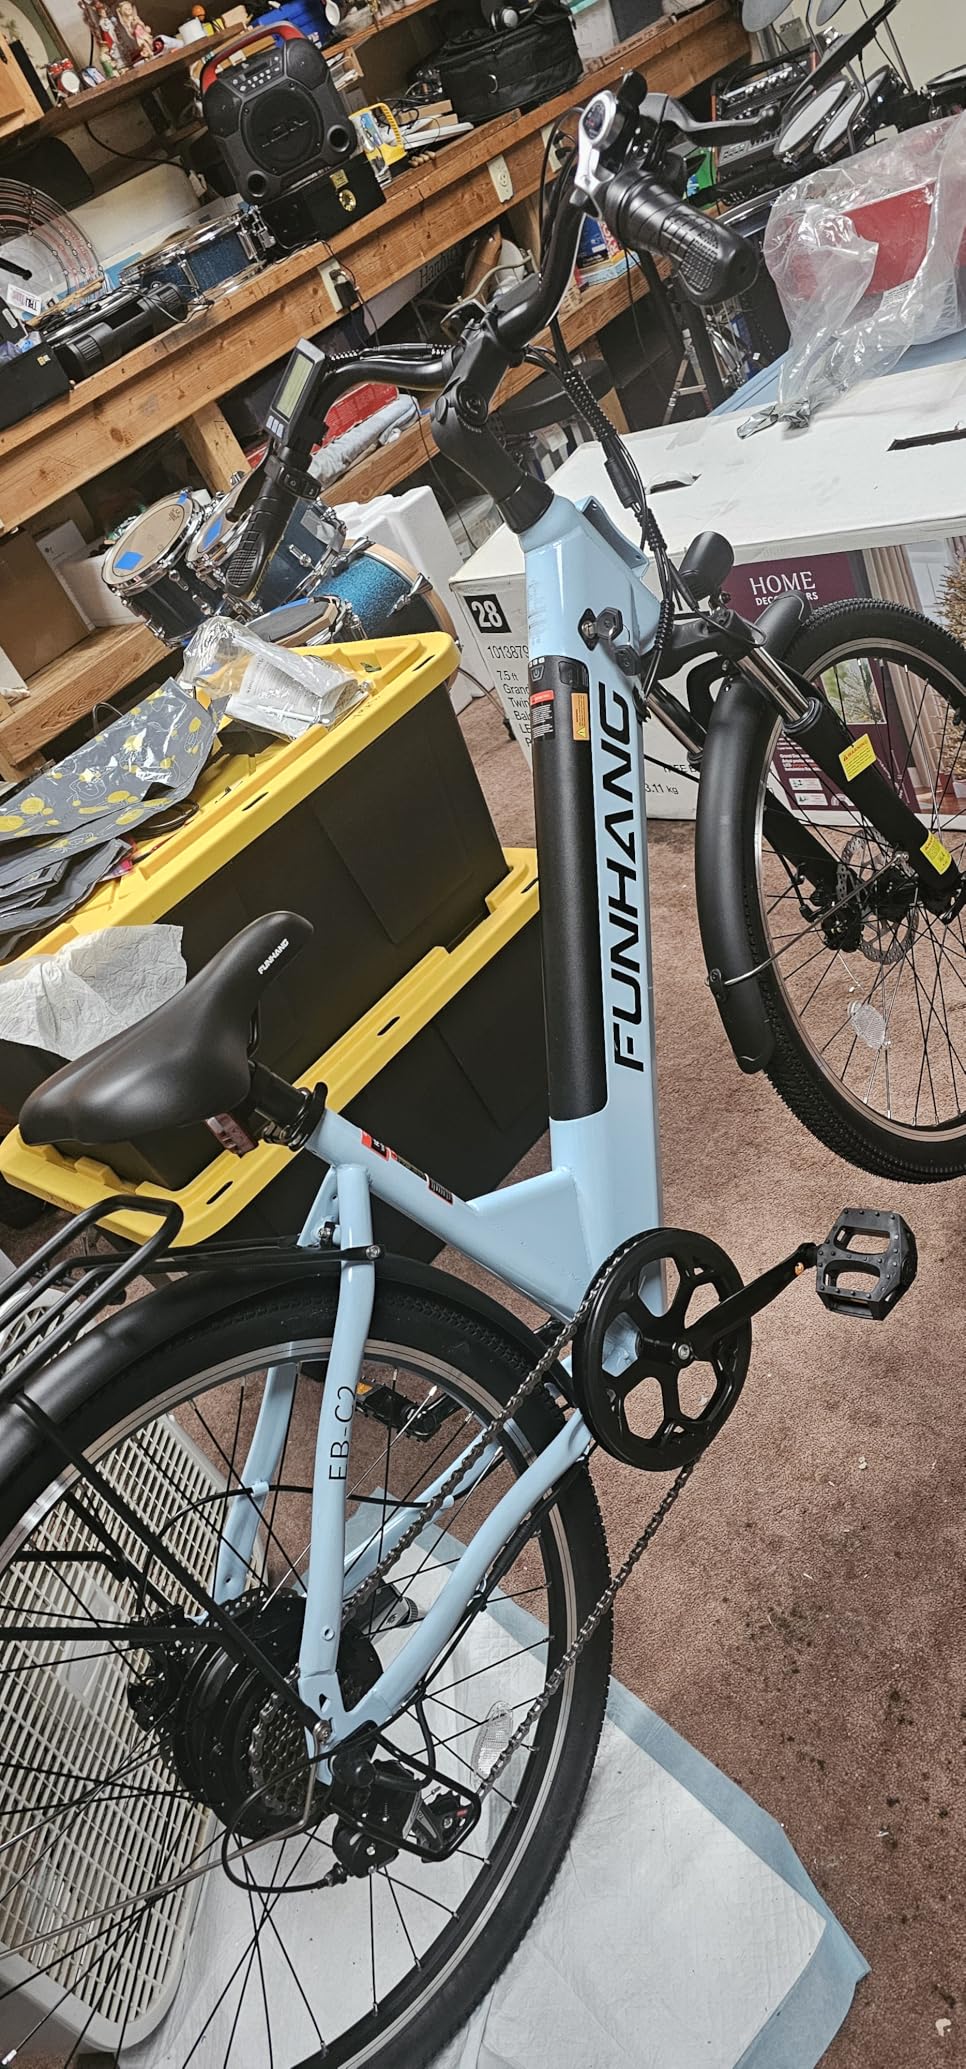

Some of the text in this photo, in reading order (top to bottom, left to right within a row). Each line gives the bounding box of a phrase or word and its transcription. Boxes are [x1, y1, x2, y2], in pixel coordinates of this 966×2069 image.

[749, 571, 816, 595] HOME
[755, 592, 819, 606] DECRS
[471, 600, 503, 628] 28
[496, 670, 519, 681] 7.5 ft
[518, 723, 532, 734] LE
[666, 784, 679, 795] kg
[598, 681, 645, 1073] FUNHANG
[257, 938, 289, 975] FUNHANG
